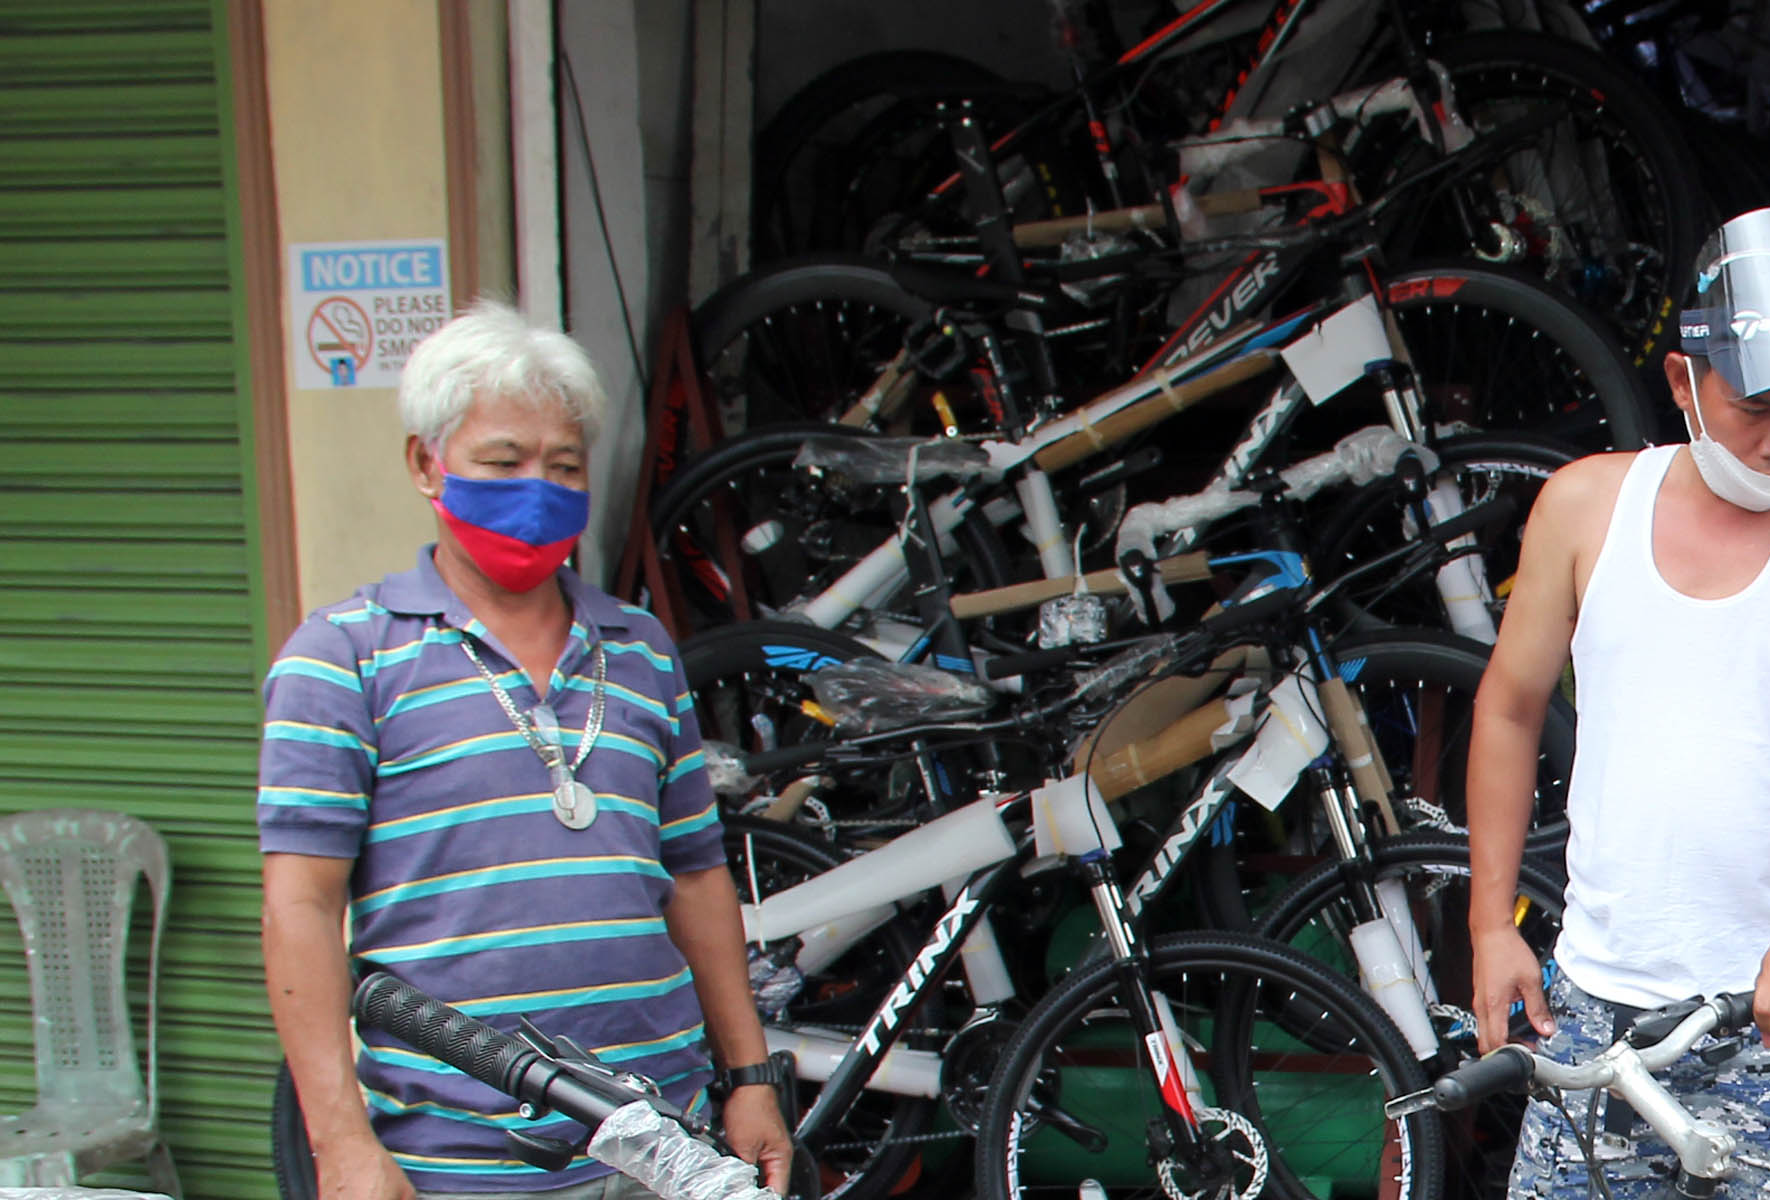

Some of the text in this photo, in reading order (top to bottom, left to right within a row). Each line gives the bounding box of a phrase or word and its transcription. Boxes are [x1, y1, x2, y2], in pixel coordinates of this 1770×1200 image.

[311, 253, 433, 287] NOTICE
[374, 294, 446, 314] PLEASE
[376, 316, 444, 335] DO NOT
[377, 338, 422, 358] SMO
[1126, 777, 1226, 917] RINX
[854, 885, 980, 1057] TRINX
